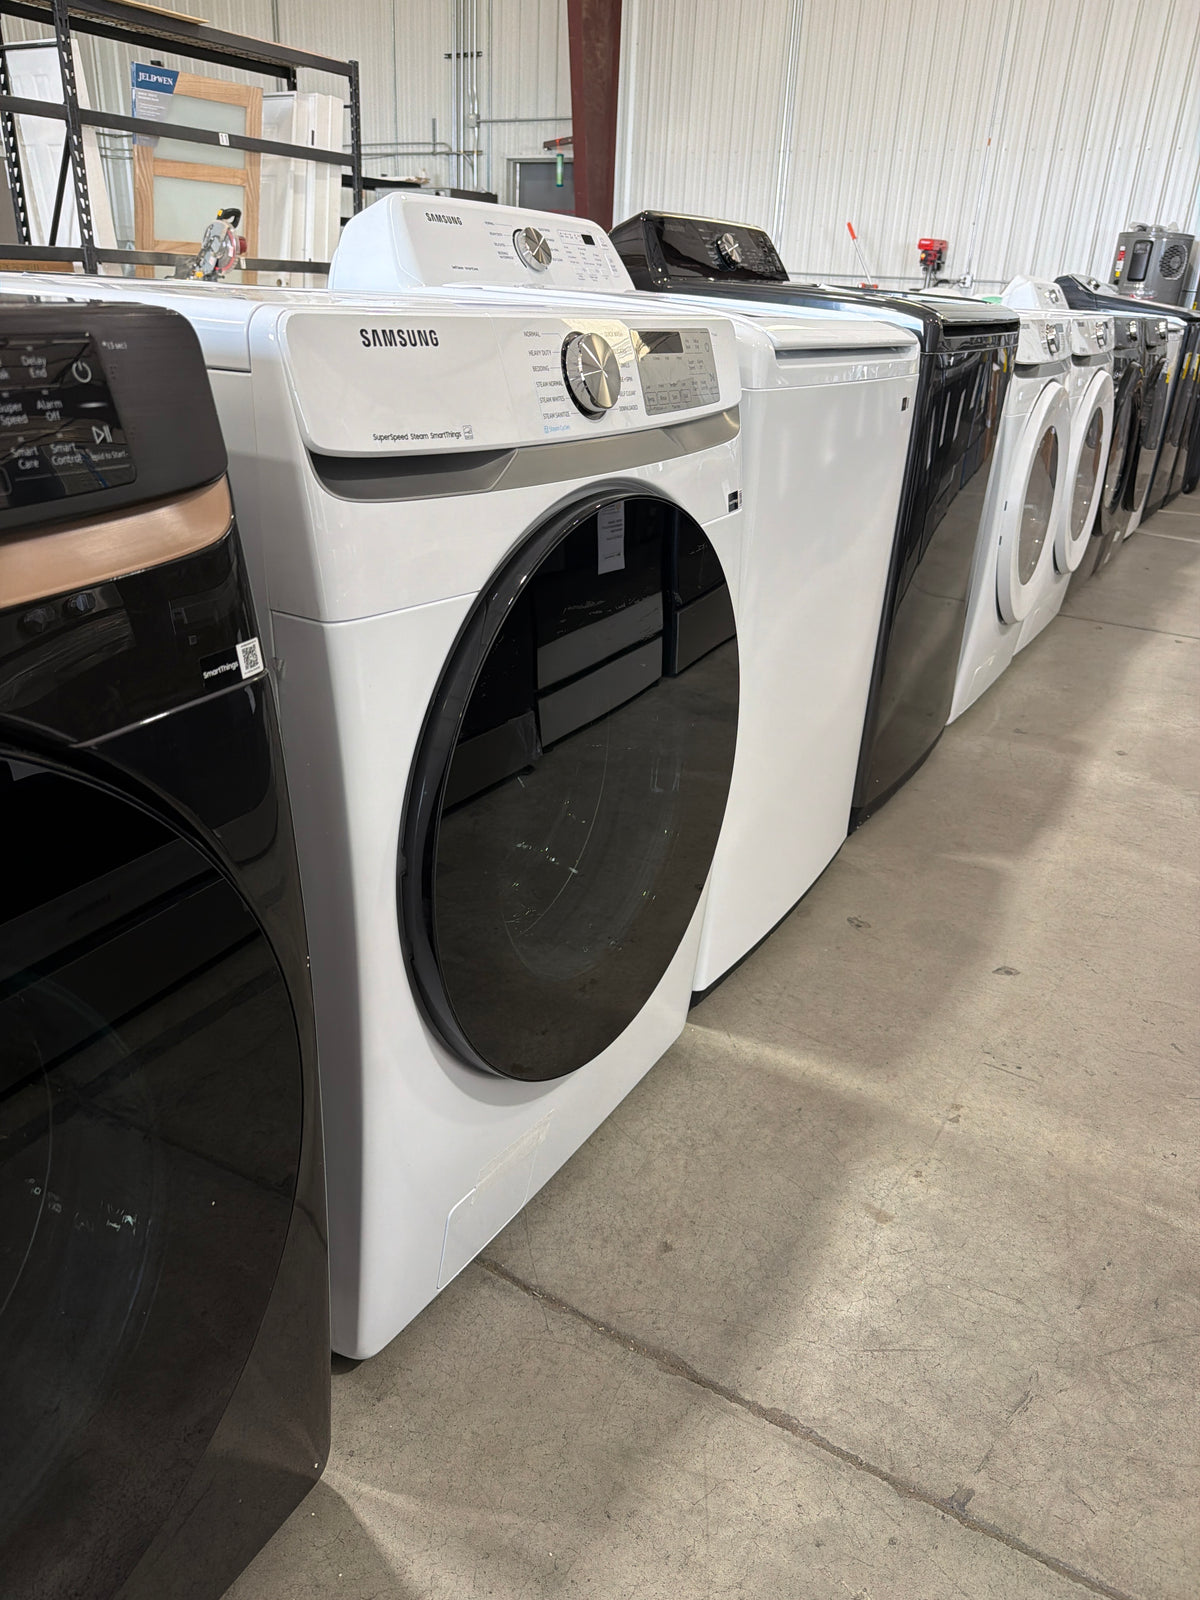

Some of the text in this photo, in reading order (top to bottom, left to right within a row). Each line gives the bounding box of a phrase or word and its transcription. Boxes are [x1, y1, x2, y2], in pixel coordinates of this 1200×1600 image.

[425, 212, 463, 226] SAMSUNG
[359, 328, 440, 348] SAMSUNG
[20, 355, 47, 367] Delay
[29, 367, 48, 378] End
[36, 399, 63, 410] Alarm
[45, 410, 61, 421] Off
[372, 430, 462, 443] SuperSpeed Steam SmartThings
[10, 442, 77, 458] Smart Smart
[17, 453, 83, 470] Care Control
[202, 660, 239, 679] SmartThings
